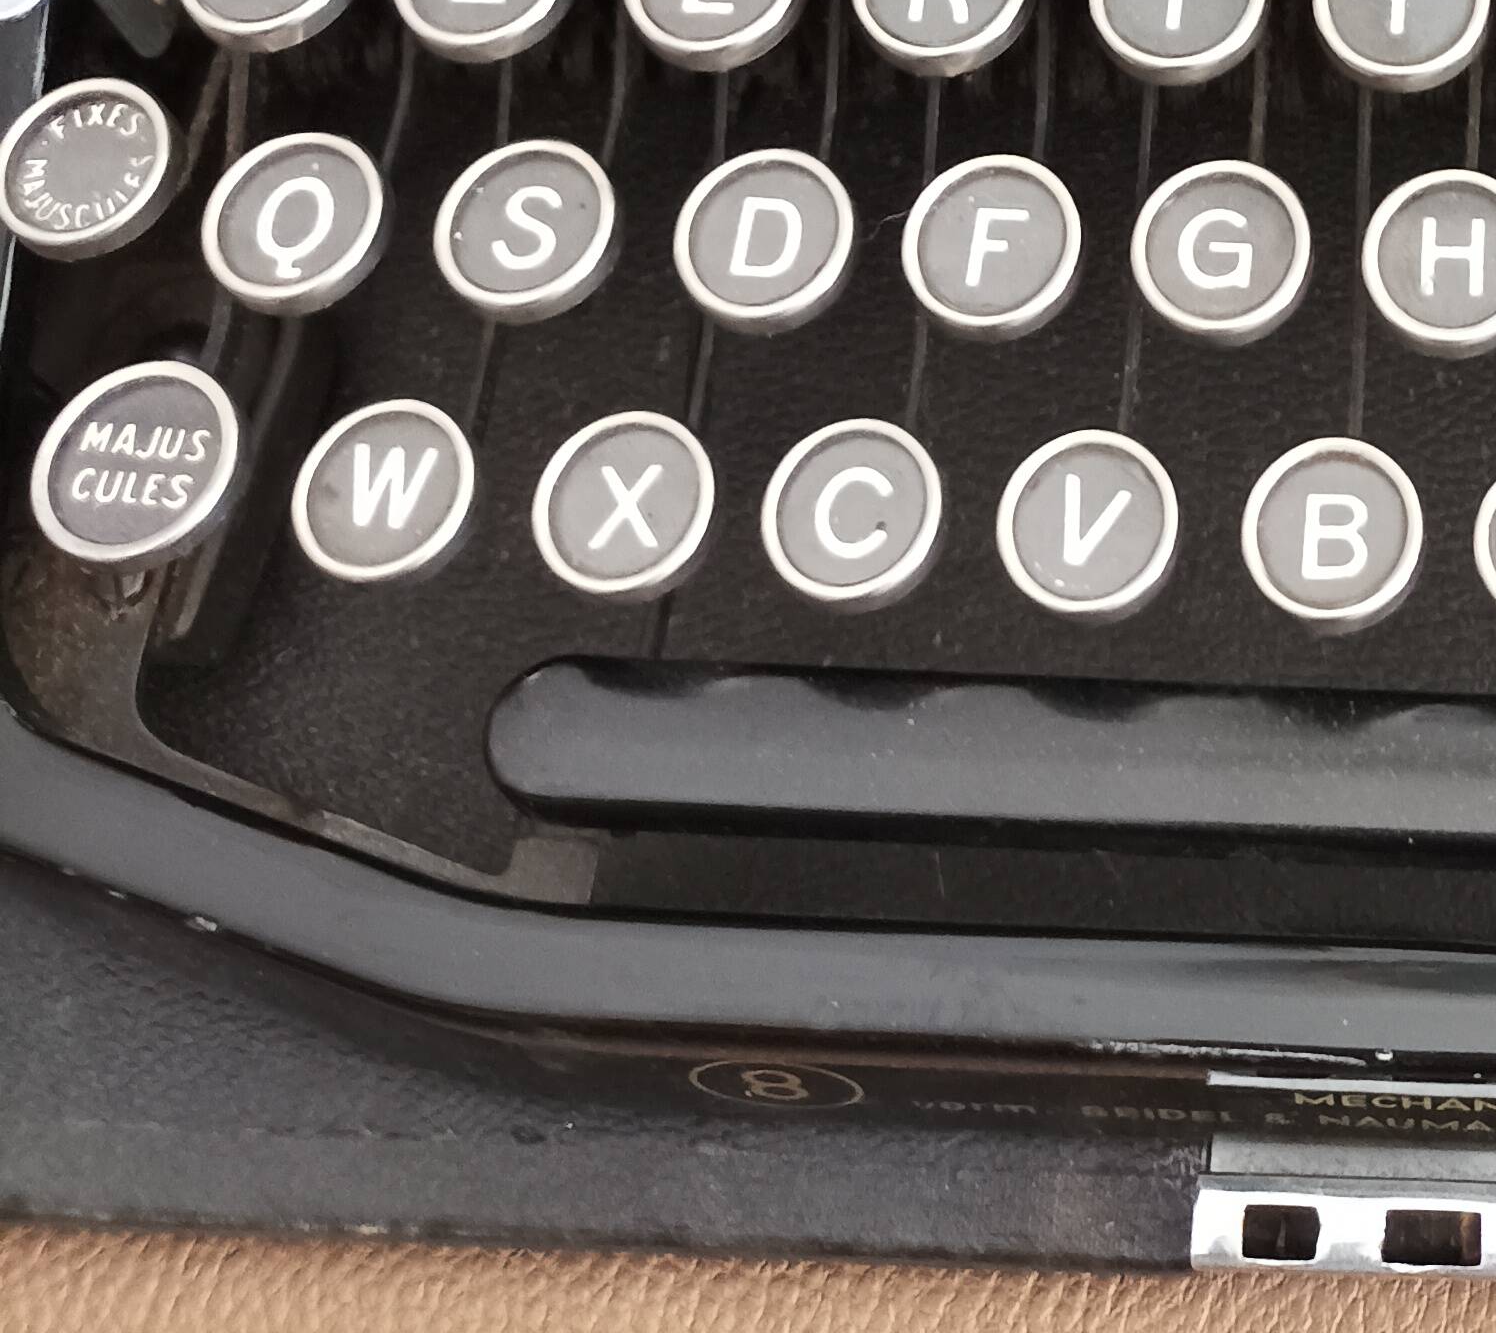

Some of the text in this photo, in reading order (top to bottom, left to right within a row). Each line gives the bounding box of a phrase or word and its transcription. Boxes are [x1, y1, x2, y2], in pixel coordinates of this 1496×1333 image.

[49, 103, 144, 140] FIXES
[256, 175, 335, 279] Q
[491, 185, 563, 271] S
[728, 196, 803, 278] D
[964, 207, 1030, 288] F
[1177, 208, 1253, 290] G
[1420, 216, 1486, 298] H
[77, 421, 212, 464] MAJUS
[70, 467, 195, 510] CULES
[351, 443, 439, 530] W
[587, 464, 664, 550] X
[814, 466, 894, 560] C
[1062, 473, 1132, 567] V
[1301, 493, 1369, 581] B
[741, 1069, 809, 1101] 8
